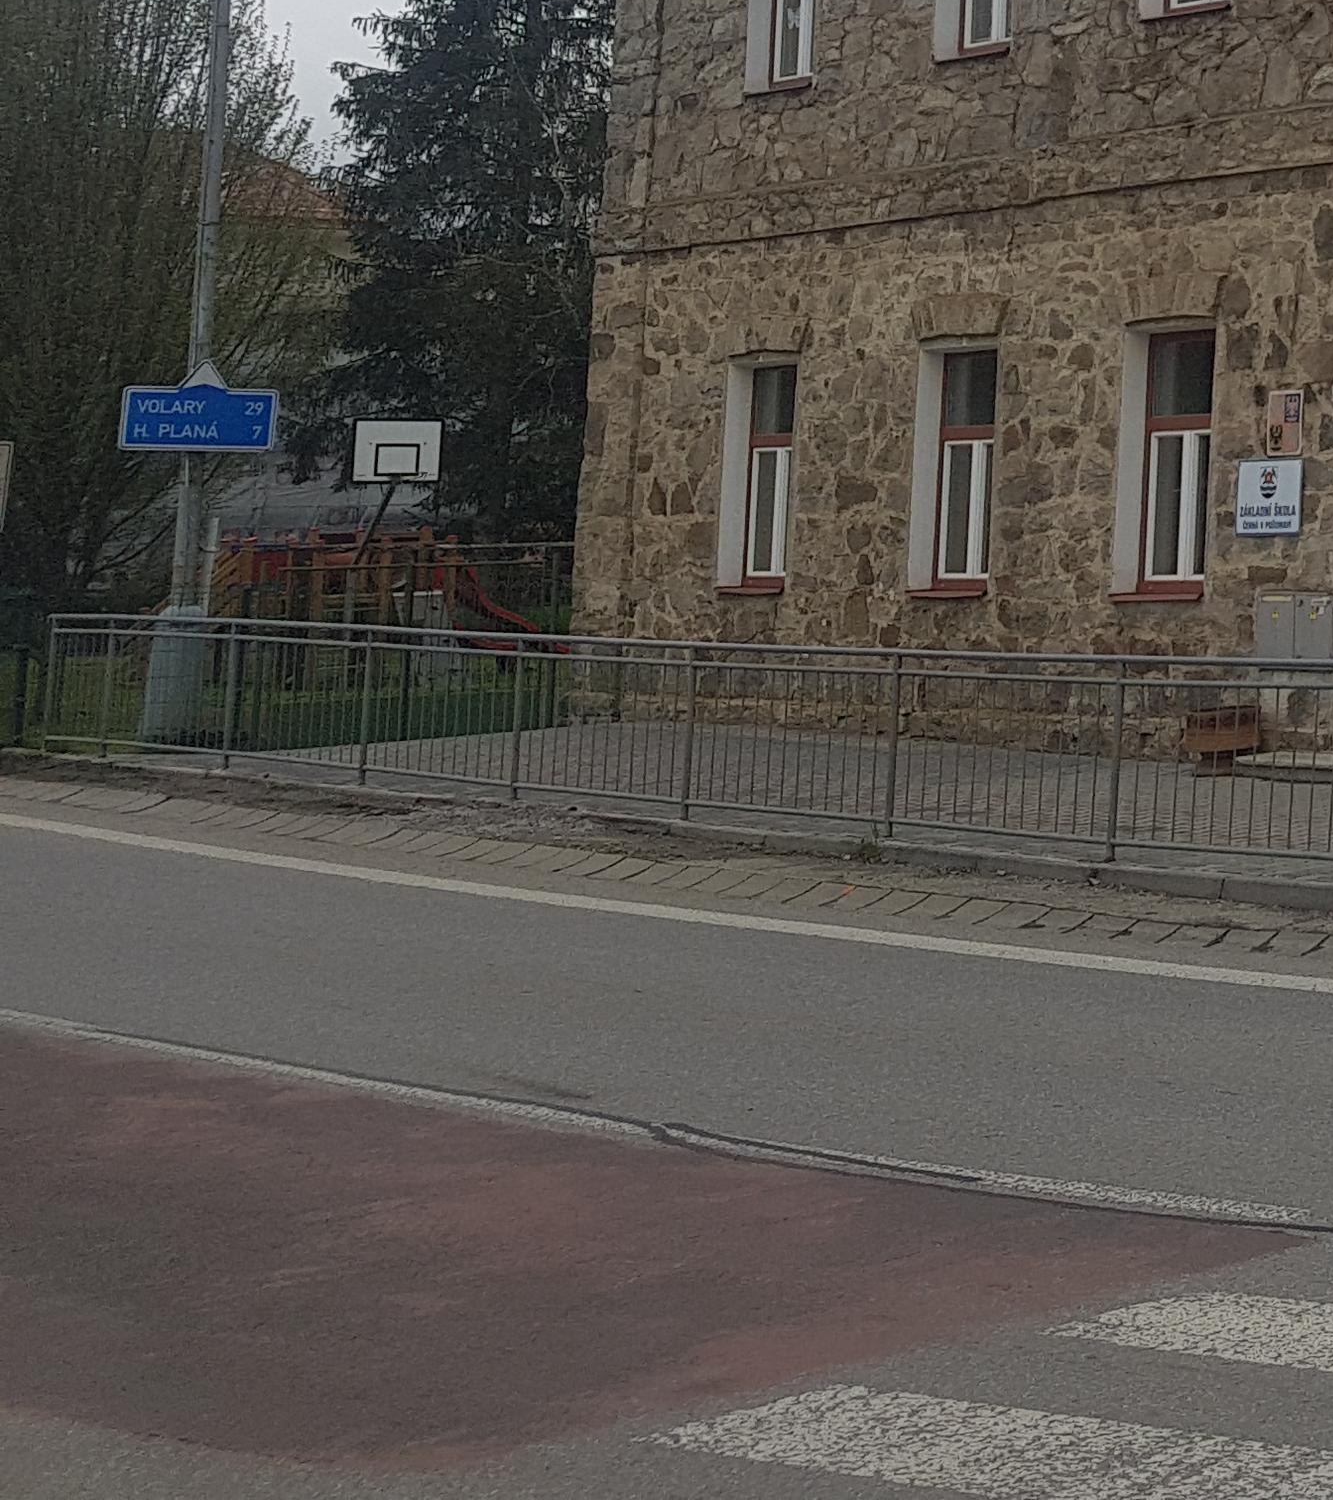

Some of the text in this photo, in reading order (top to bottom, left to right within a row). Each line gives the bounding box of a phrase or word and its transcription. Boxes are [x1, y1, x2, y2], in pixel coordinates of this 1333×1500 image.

[136, 399, 264, 415] VOLARY 29
[158, 421, 219, 439] PLANÁ
[252, 426, 262, 440] 7
